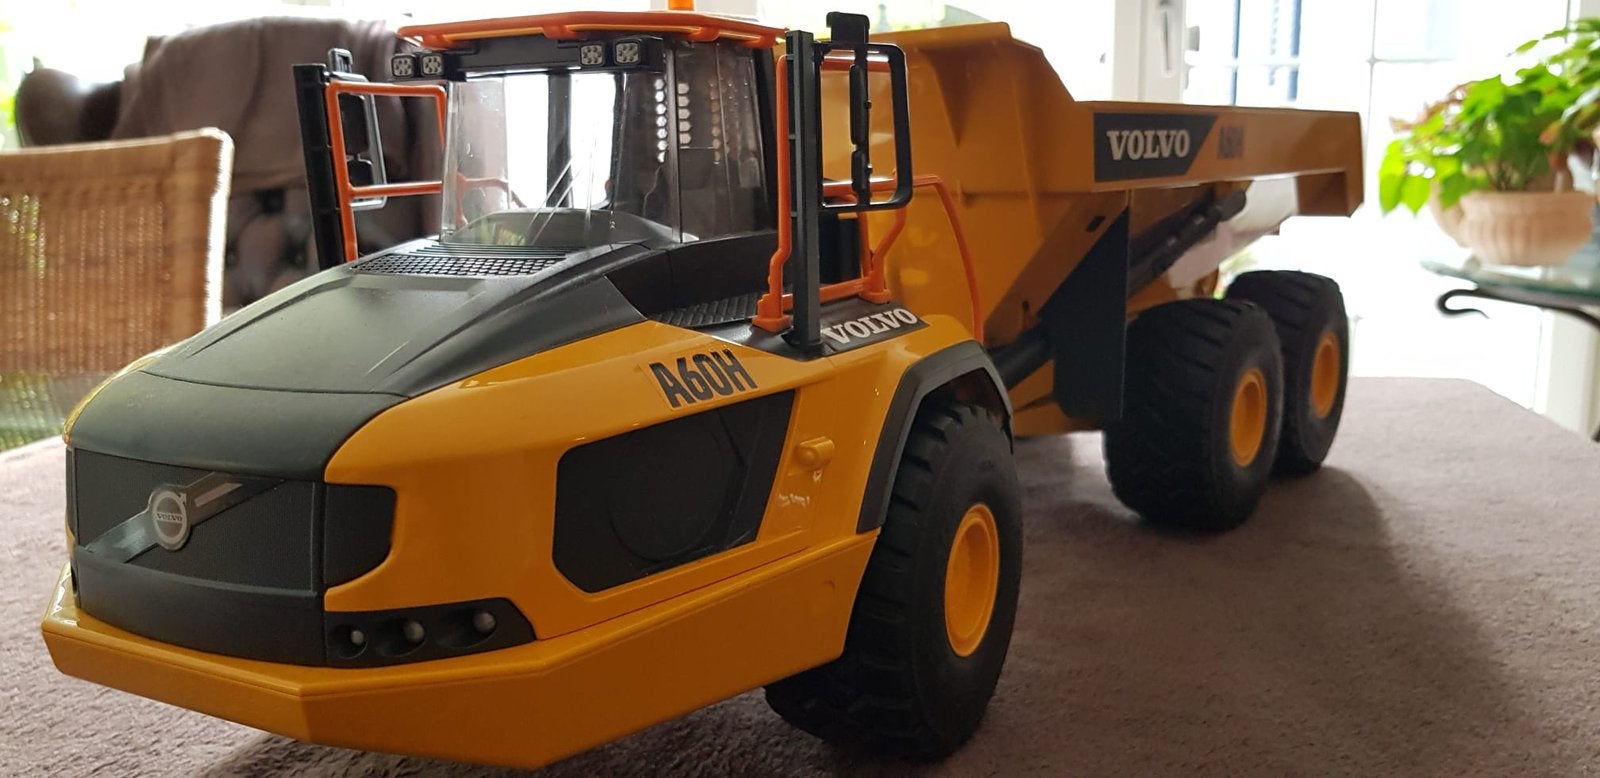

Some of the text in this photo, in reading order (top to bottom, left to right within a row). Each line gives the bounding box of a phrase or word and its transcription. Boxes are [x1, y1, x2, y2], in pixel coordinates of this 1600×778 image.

[1107, 129, 1190, 160] VOLVO
[820, 308, 918, 344] VOLVO
[649, 348, 758, 408] A60H
